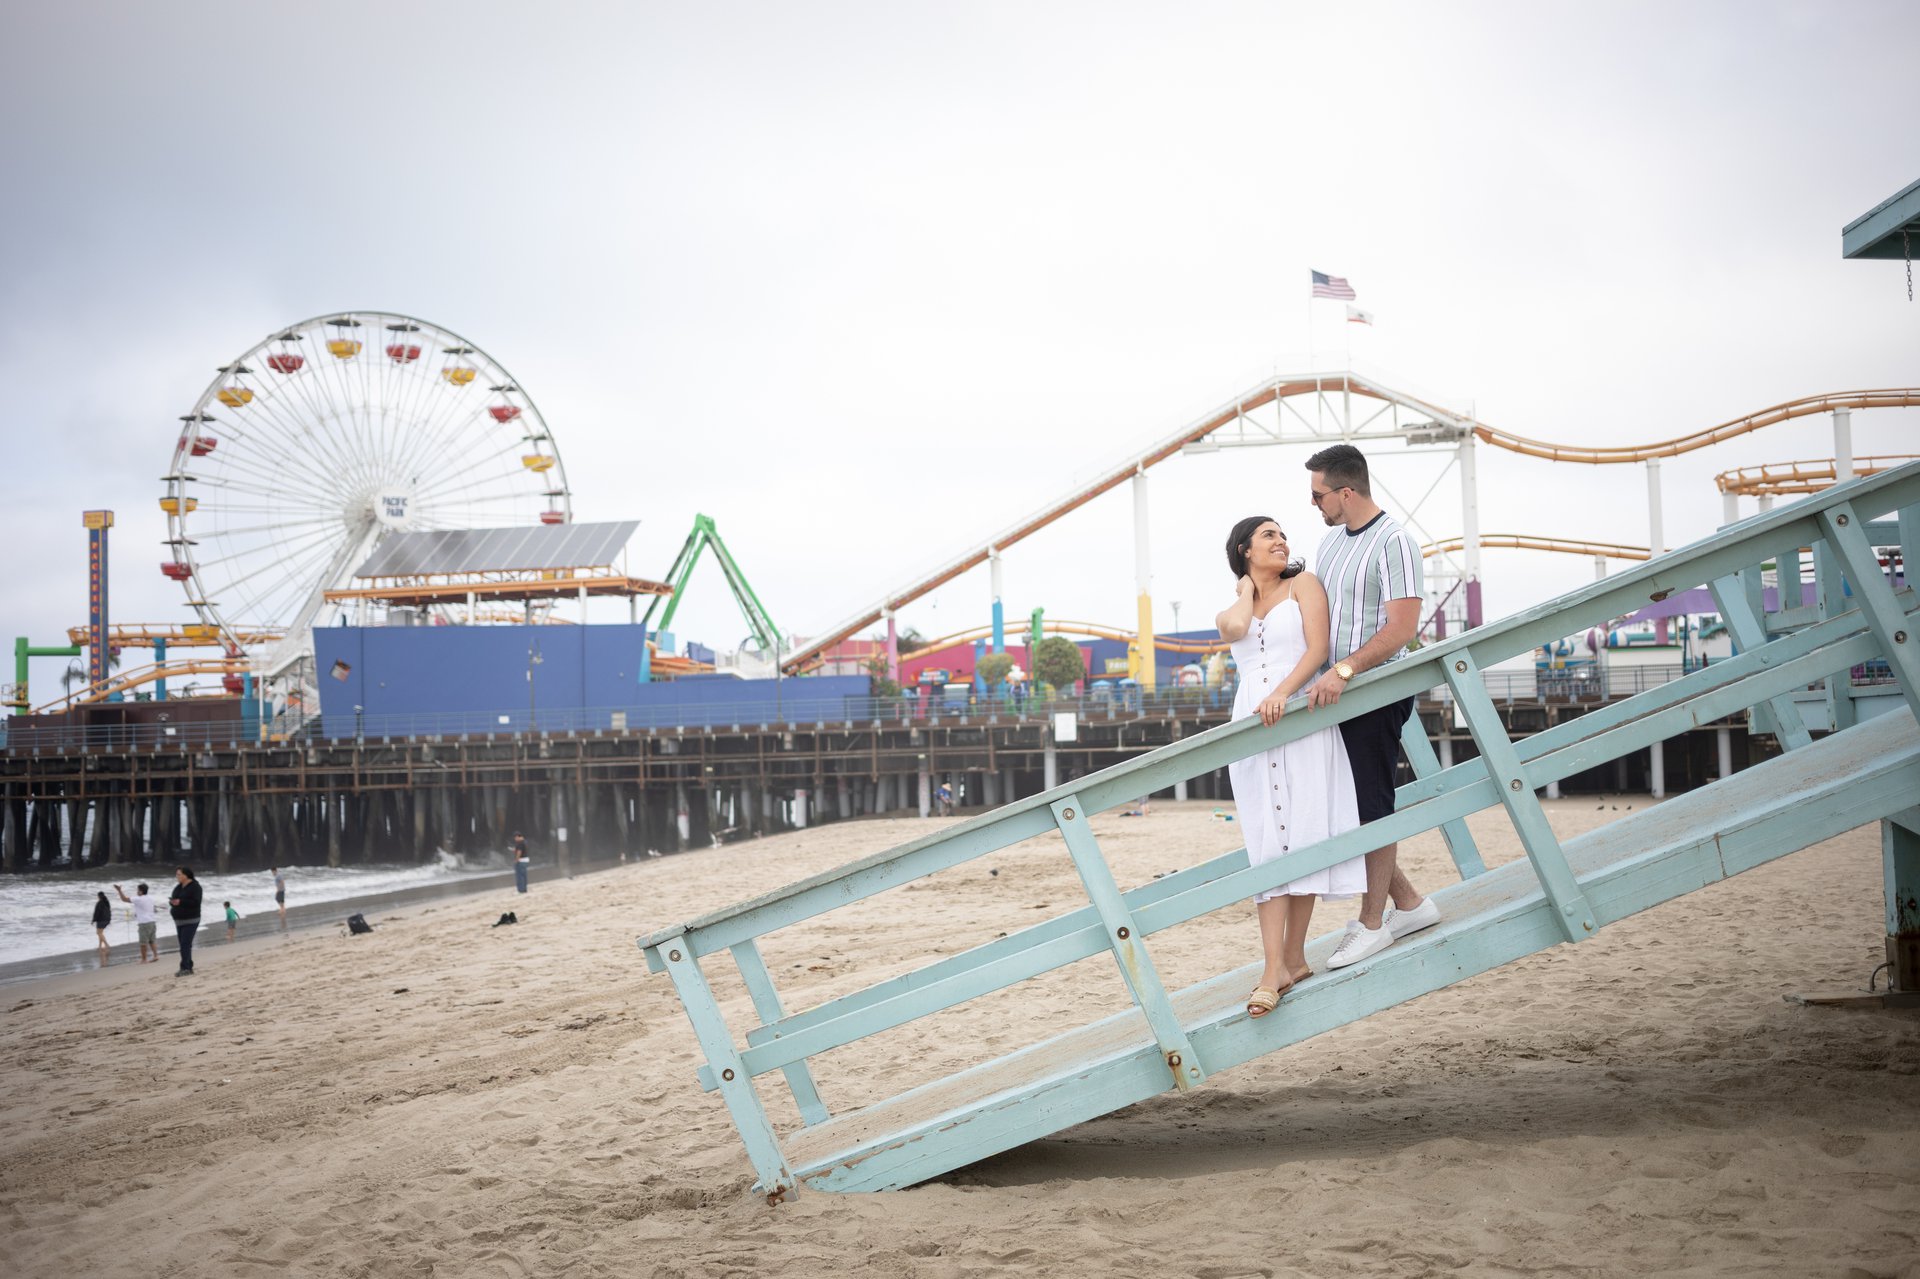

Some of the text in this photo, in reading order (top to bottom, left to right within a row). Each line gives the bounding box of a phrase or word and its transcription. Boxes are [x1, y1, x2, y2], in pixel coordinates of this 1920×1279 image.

[382, 497, 408, 507] PACIFIC
[386, 508, 404, 517] PARK
[91, 541, 99, 614] PACIFIC
